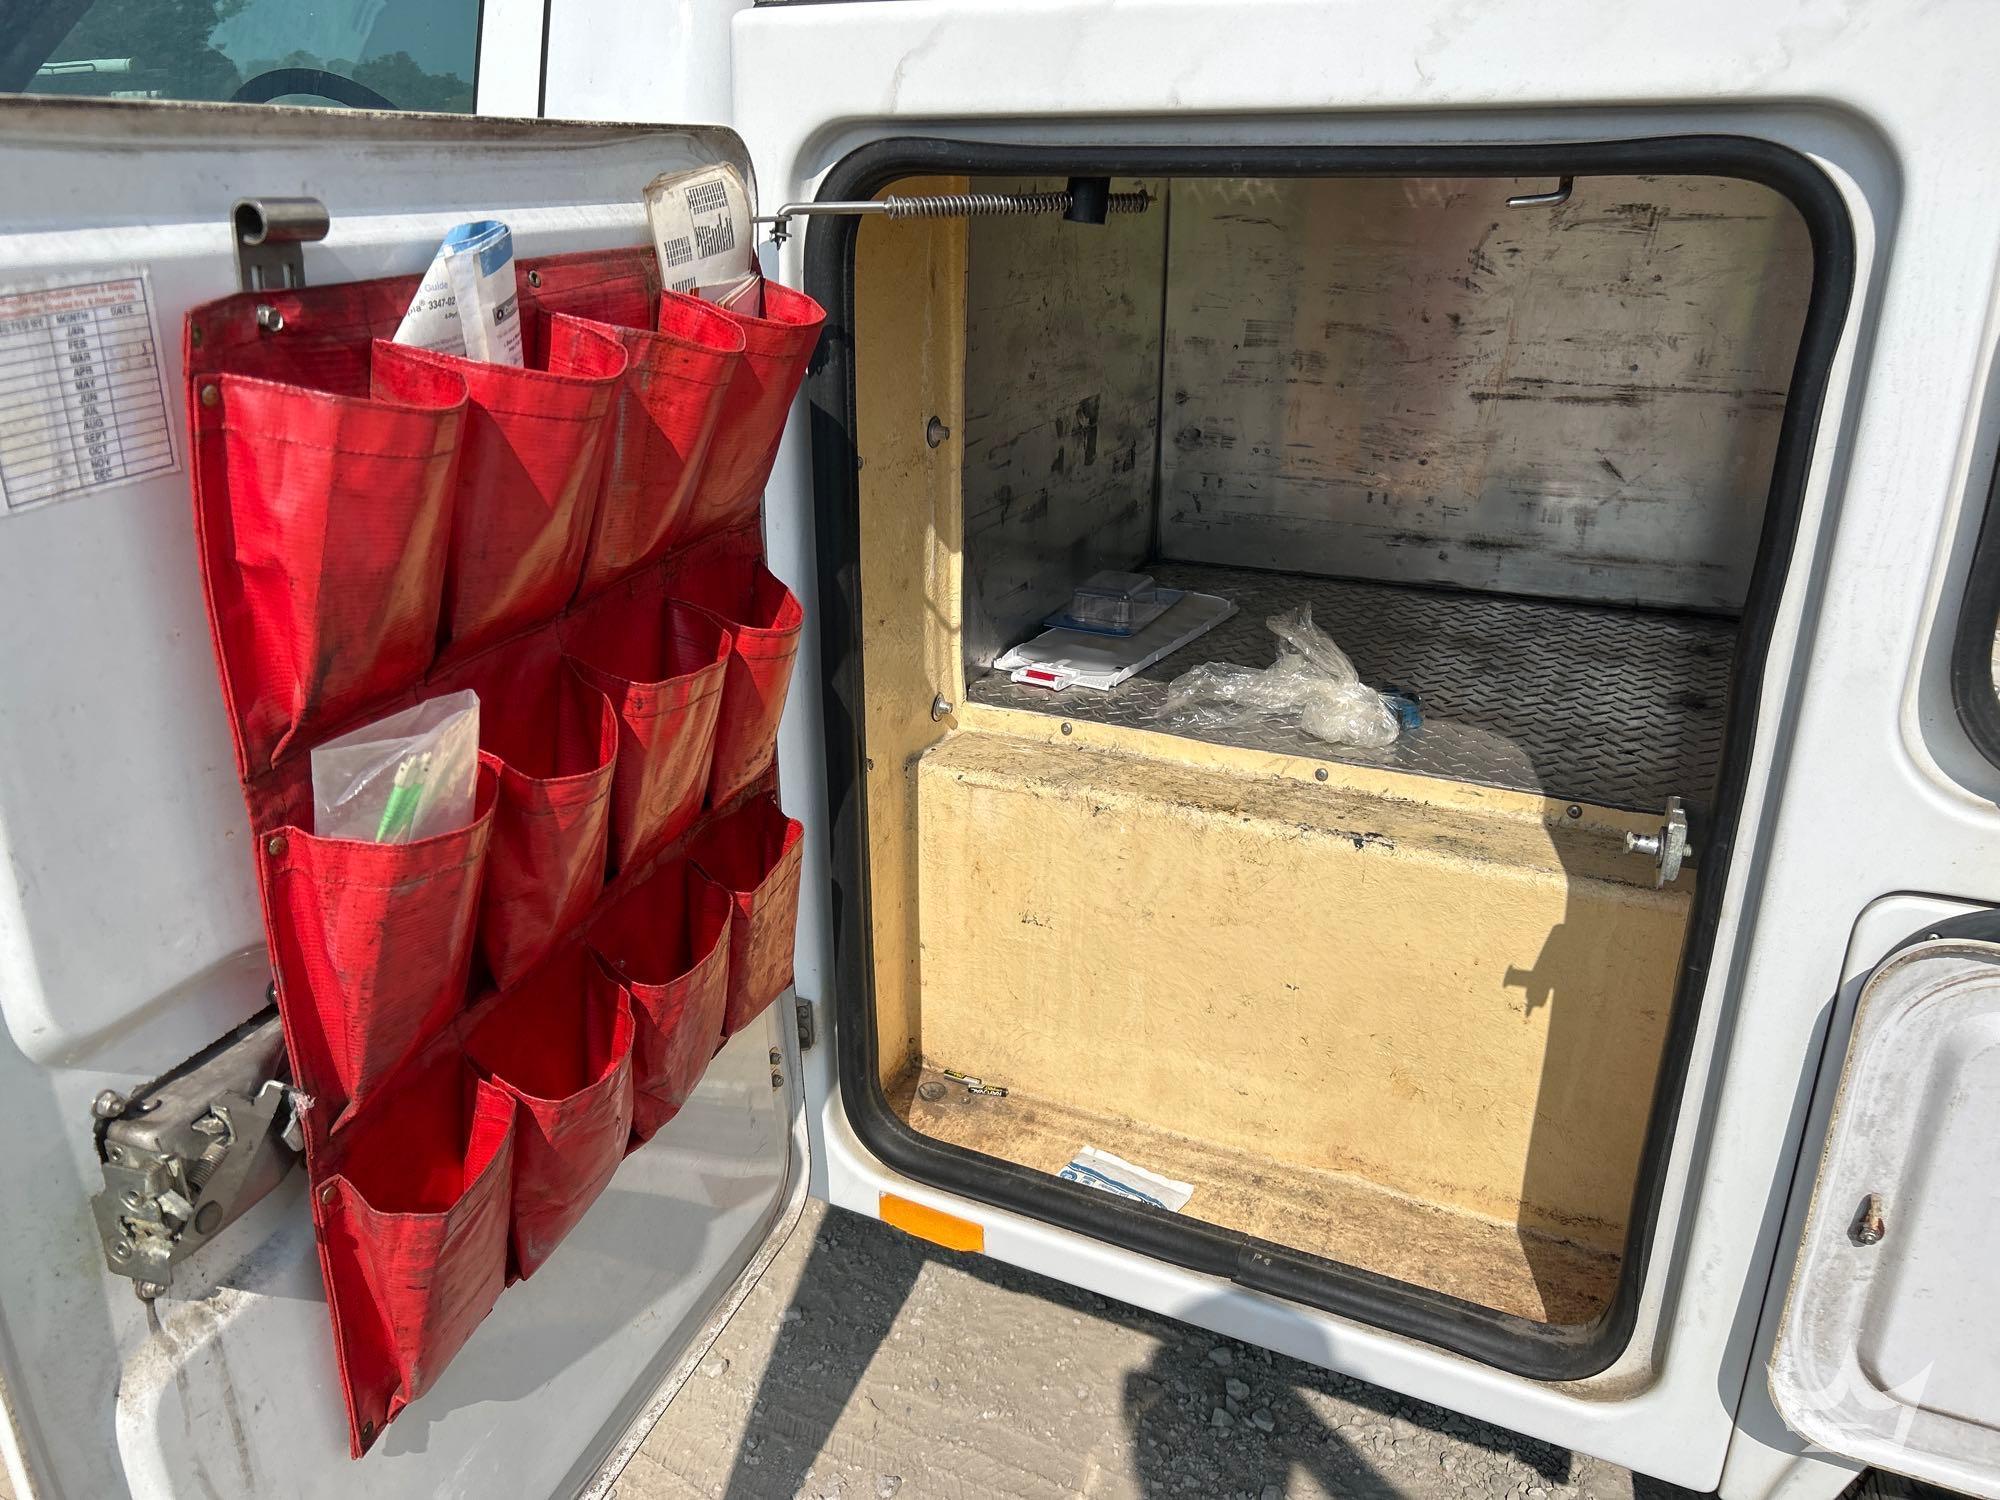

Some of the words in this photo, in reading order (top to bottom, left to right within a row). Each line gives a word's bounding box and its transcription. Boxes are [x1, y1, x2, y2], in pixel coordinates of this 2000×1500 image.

[425, 280, 448, 292] Guide
[428, 296, 456, 310] 3347-02
[111, 304, 134, 316] DATE
[56, 311, 89, 323] MONTH
[67, 324, 85, 336] JAN
[68, 338, 88, 350] FEB
[69, 352, 91, 364] MAR
[73, 366, 93, 378] APR
[75, 378, 96, 390] MAY
[79, 391, 98, 404] JUN
[84, 418, 104, 430] AUG
[84, 431, 107, 443] SEPT
[89, 444, 107, 456] OCT
[91, 456, 111, 468] NOV
[93, 467, 113, 480] DEC
